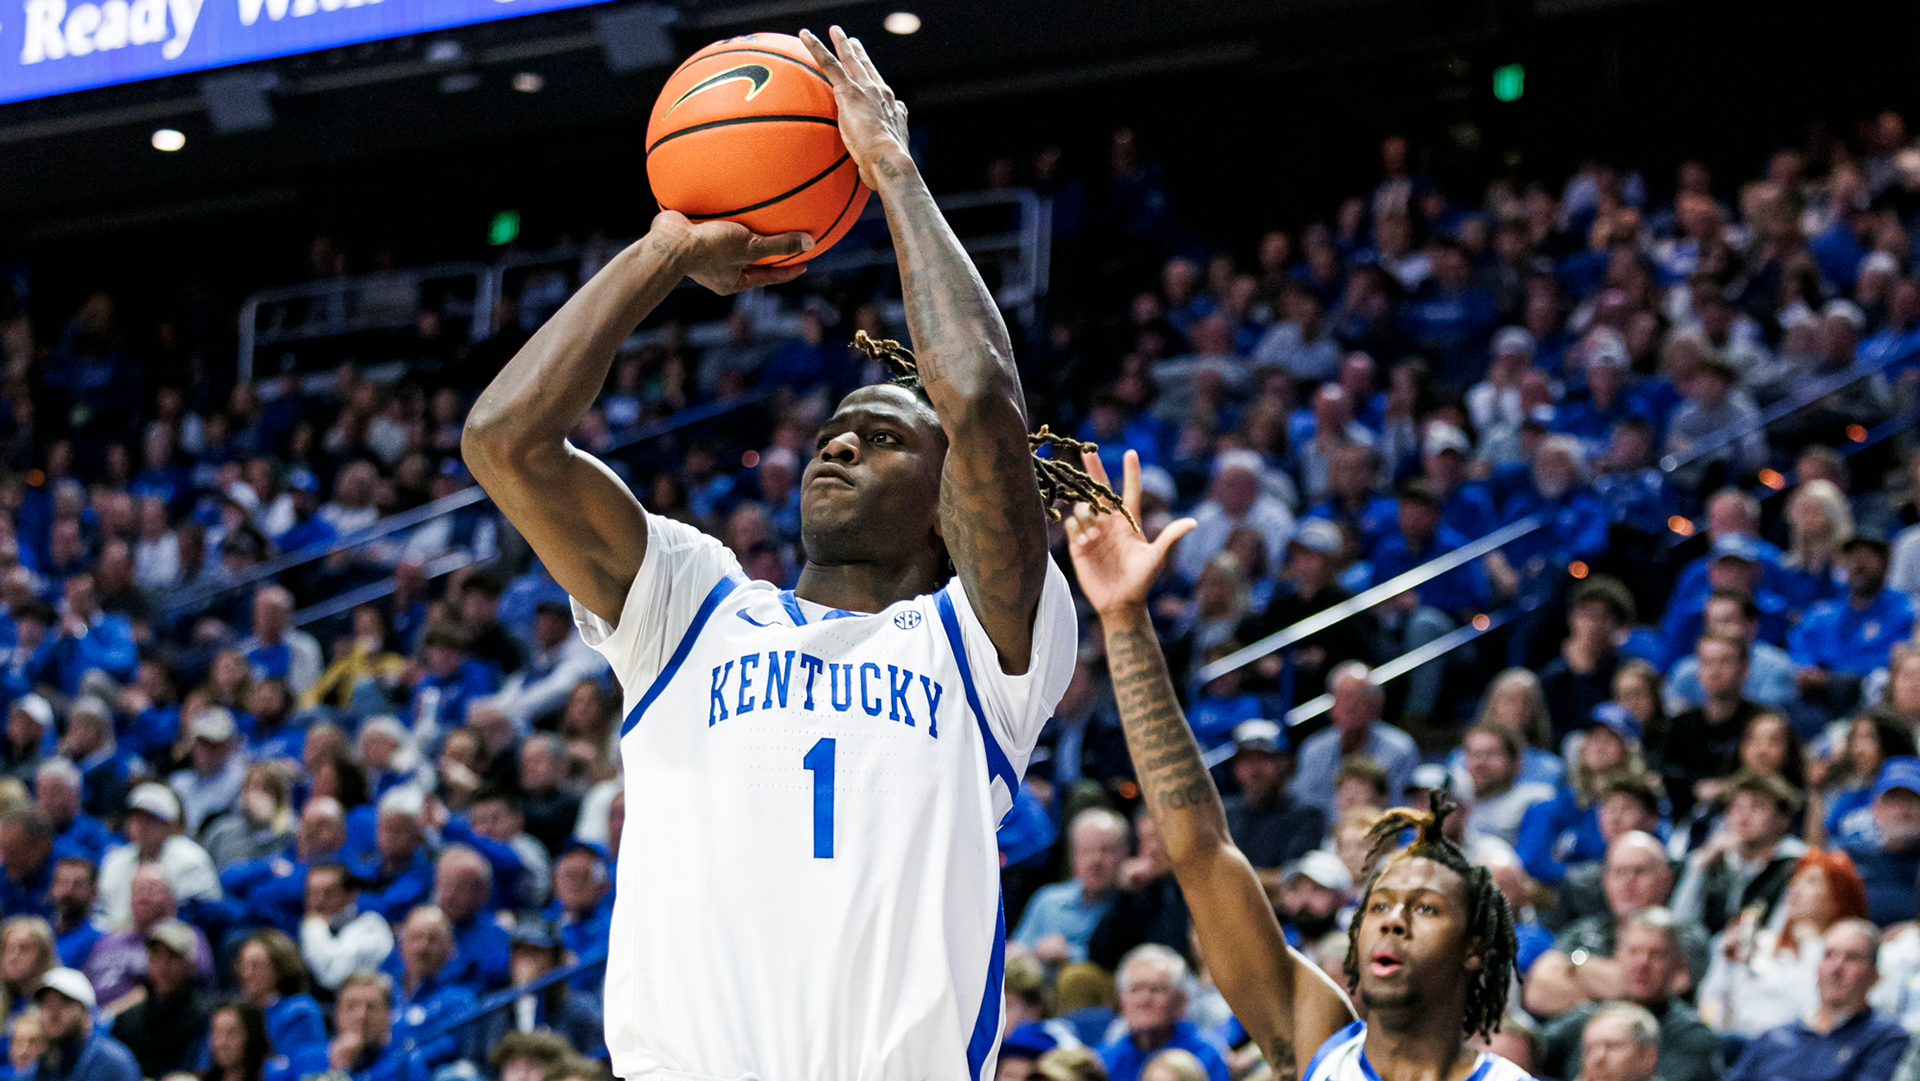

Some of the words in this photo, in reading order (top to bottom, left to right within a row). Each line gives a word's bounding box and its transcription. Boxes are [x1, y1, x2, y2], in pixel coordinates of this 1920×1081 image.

[20, 0, 203, 65] Ready
[894, 610, 922, 630] SEC
[709, 650, 942, 739] KENTUCKY
[803, 737, 836, 859] 1
